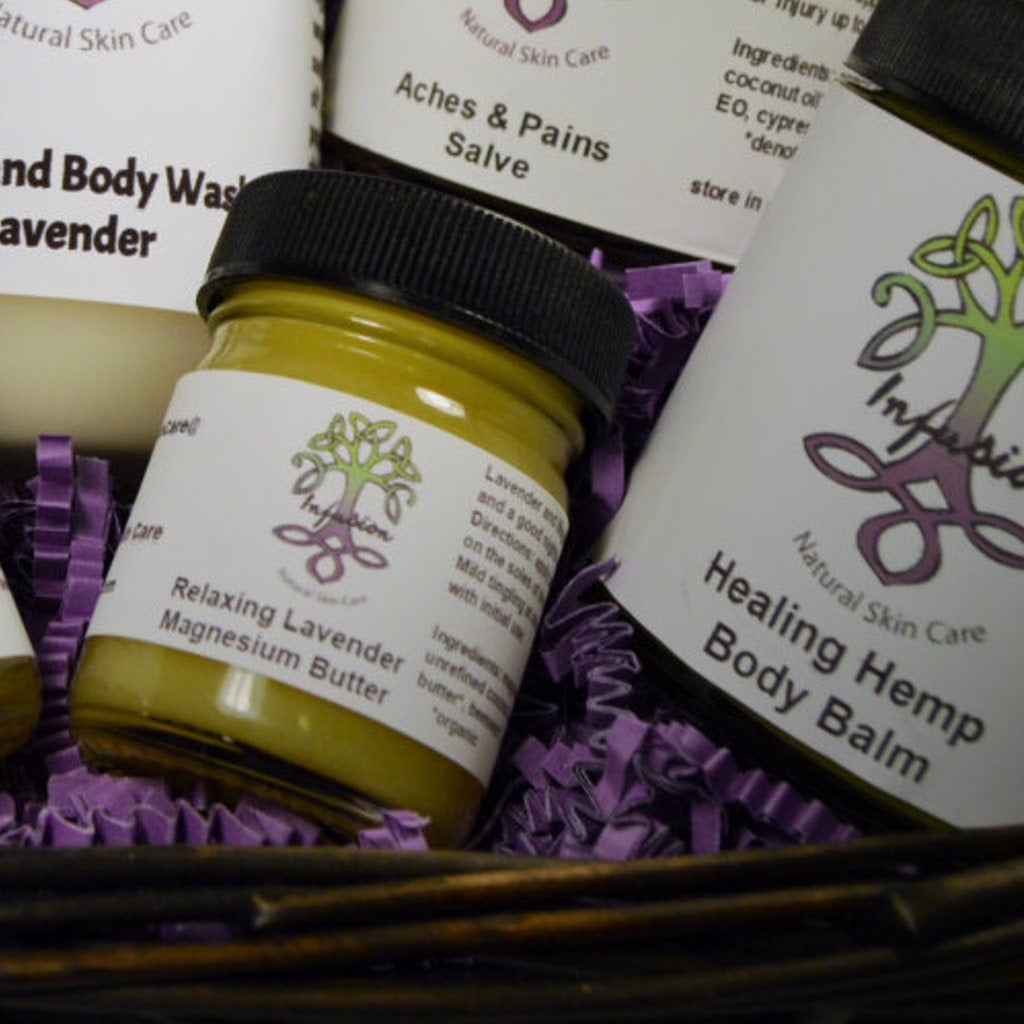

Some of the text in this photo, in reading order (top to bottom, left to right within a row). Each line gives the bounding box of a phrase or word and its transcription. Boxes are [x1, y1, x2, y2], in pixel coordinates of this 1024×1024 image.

[79, 26, 135, 54] Skin
[139, 9, 195, 47] Care
[458, 5, 612, 71] Natural Skin Care
[832, 10, 851, 33] up
[715, 92, 751, 123] EO,
[723, 68, 802, 104] coconut
[394, 72, 613, 165] Aches & Pains
[444, 131, 531, 181] Salve
[61, 153, 160, 210] Body
[165, 165, 246, 212] Was
[690, 178, 764, 213] store in
[477, 490, 507, 515] and
[484, 464, 543, 513] Lavender
[299, 493, 395, 543] Infusion
[792, 529, 989, 646] Natural Skin Care
[172, 576, 406, 676] Relaxing Lavender
[702, 549, 987, 746] Healing Hemp
[159, 607, 392, 706] Magnesium Butter
[702, 621, 933, 784] Body Balm
